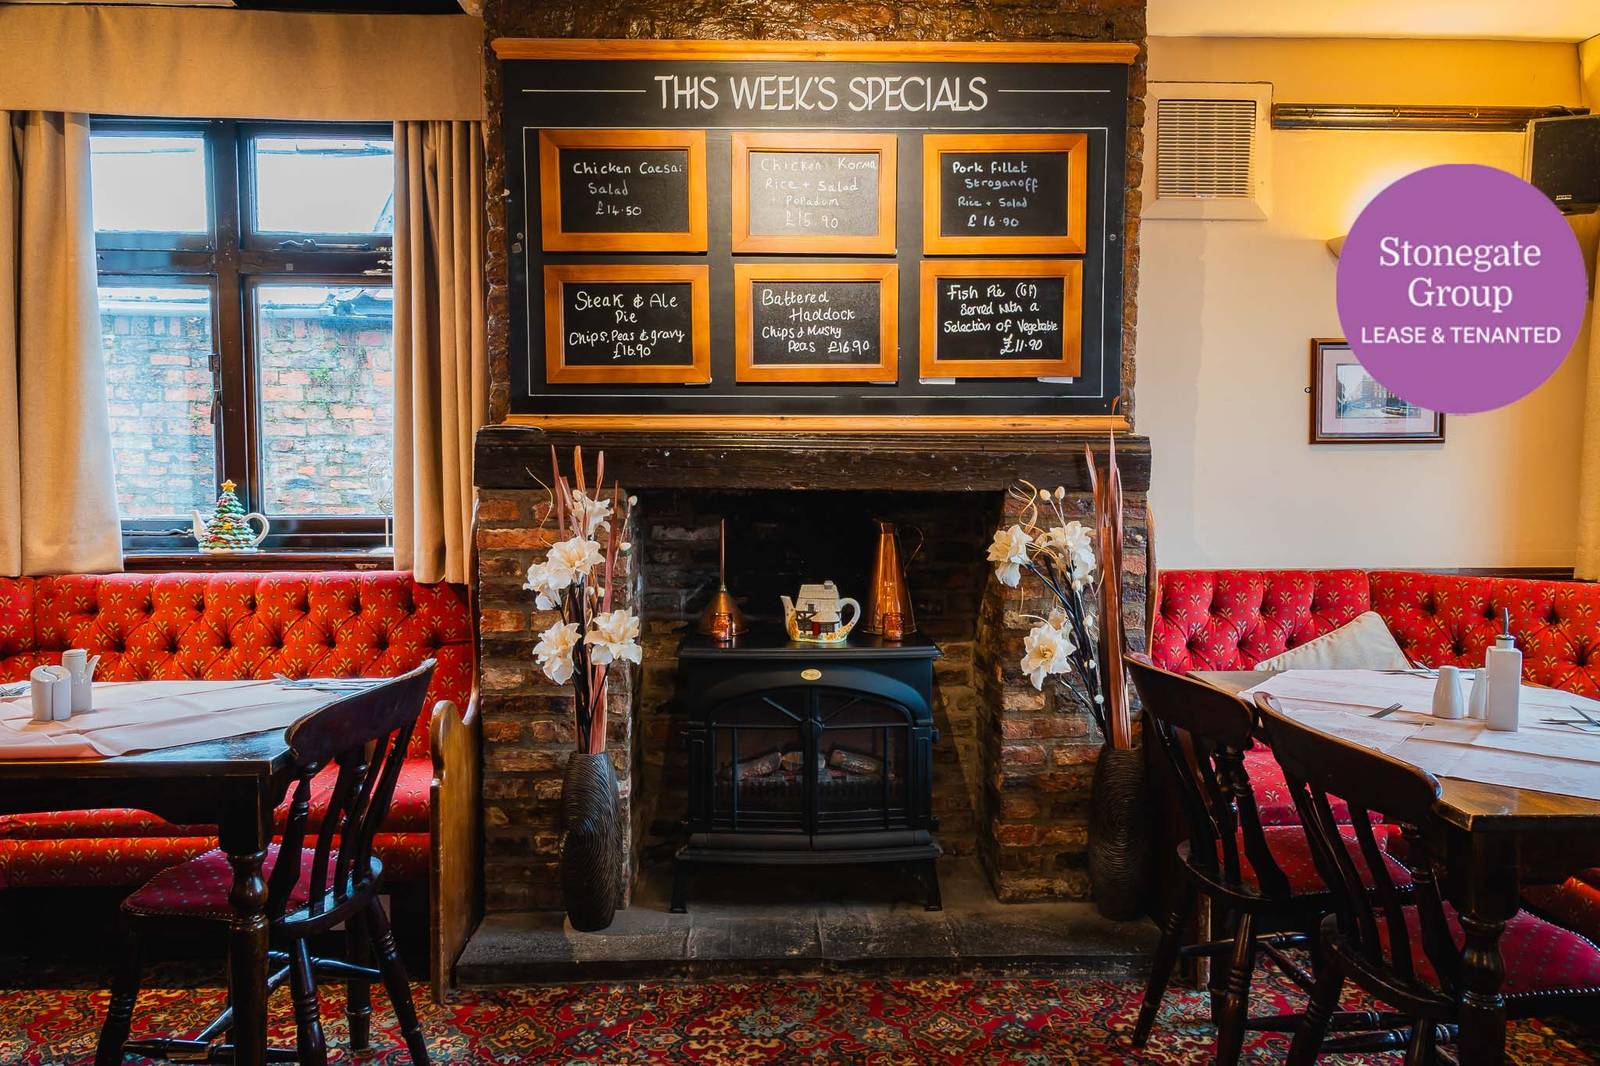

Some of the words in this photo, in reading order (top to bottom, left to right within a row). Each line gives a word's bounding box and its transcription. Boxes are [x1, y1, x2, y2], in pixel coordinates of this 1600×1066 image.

[654, 75, 719, 109] THIS
[729, 75, 838, 111] WEEK'S
[848, 76, 988, 112] SPECIALS
[573, 162, 631, 174] Chicken
[761, 158, 821, 171] Chicken
[952, 162, 983, 173] Pork
[588, 179, 628, 194] Salad
[765, 177, 800, 190] Rice
[817, 177, 859, 192] Salad
[965, 178, 1038, 193] Stroganoff
[958, 196, 982, 206] Rice
[999, 198, 1027, 208] Salad
[762, 289, 829, 306] Battered
[947, 285, 978, 300] Fish
[987, 284, 1005, 297] Pie
[575, 291, 624, 310] Steak
[633, 294, 644, 308] &
[650, 293, 678, 308] Ale
[615, 310, 637, 323] Pie
[789, 308, 855, 322] Haddock
[960, 302, 994, 316] Served
[1030, 303, 1039, 311] a
[762, 326, 795, 340] Chips
[808, 325, 841, 338] Mushy
[944, 318, 990, 333] Selection
[996, 320, 1012, 332] of
[611, 330, 634, 342] Peas
[651, 329, 685, 345] gravy
[613, 342, 651, 359] £16.90
[788, 340, 815, 353] Peas
[828, 340, 869, 355] £16.90
